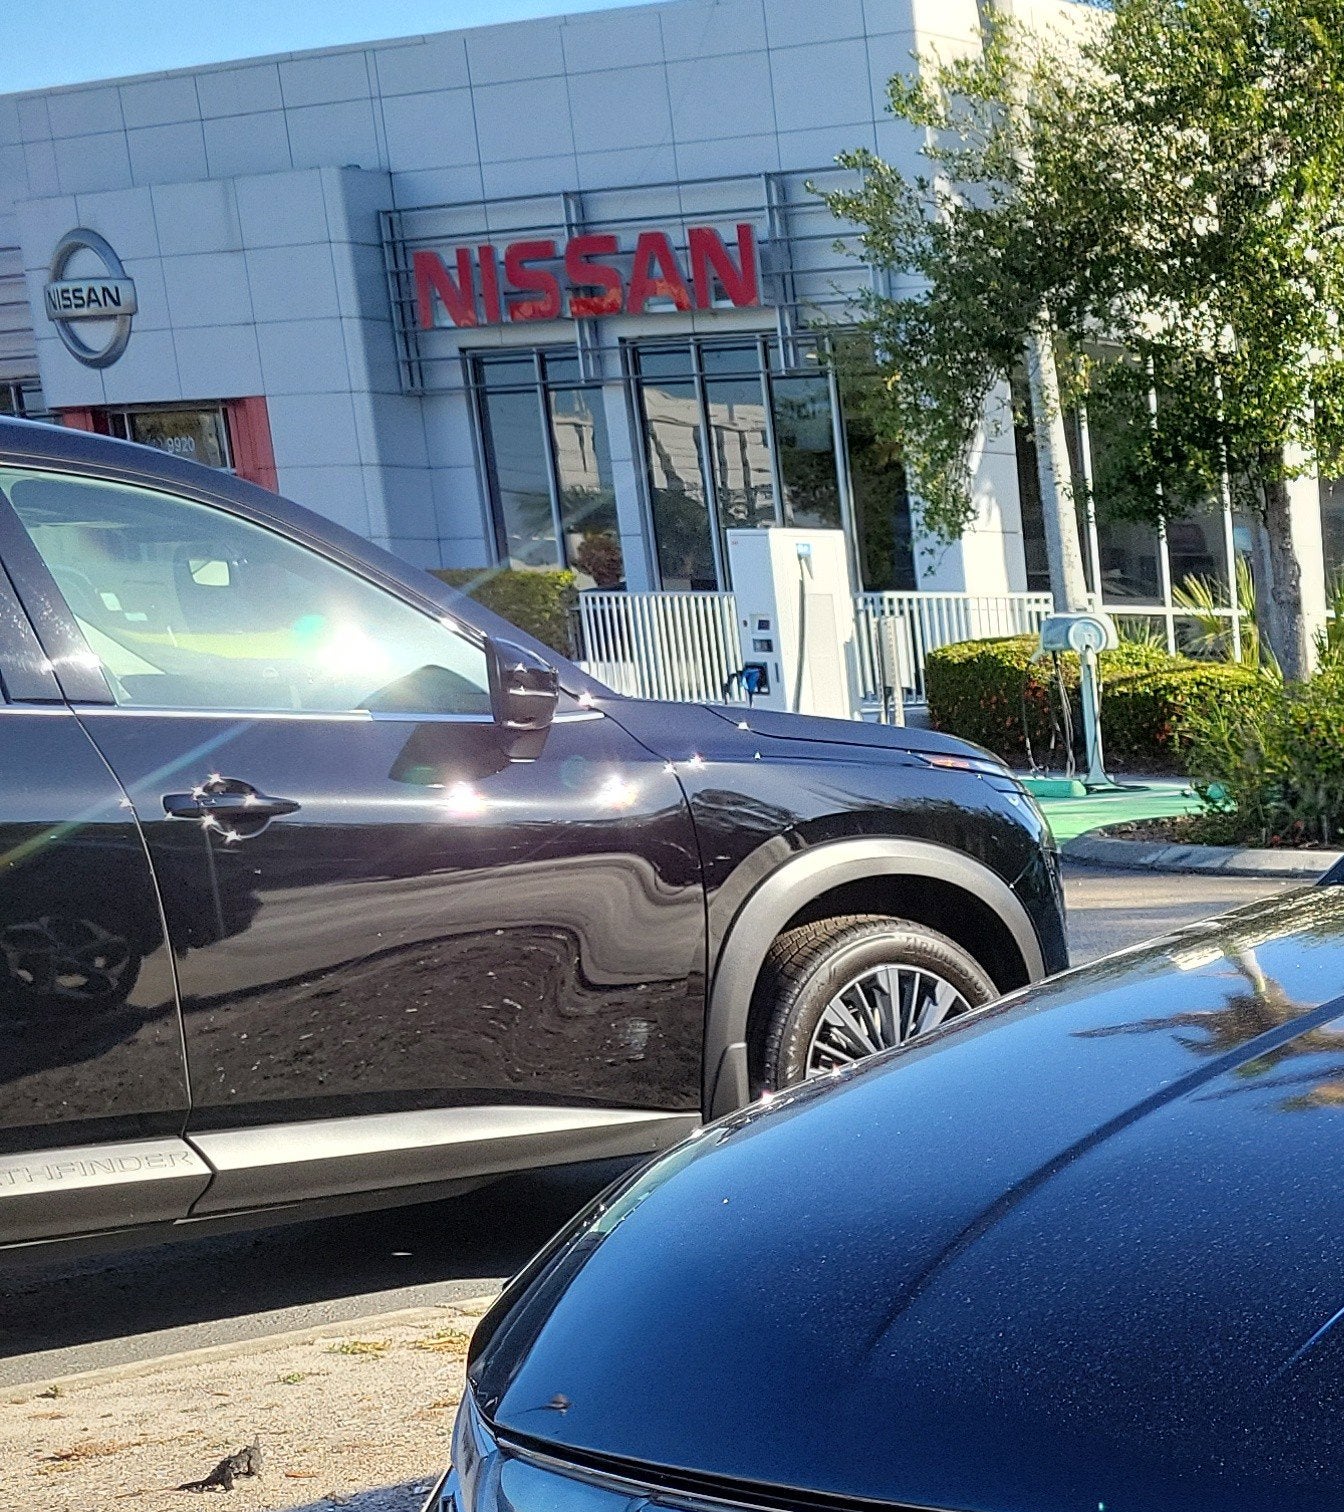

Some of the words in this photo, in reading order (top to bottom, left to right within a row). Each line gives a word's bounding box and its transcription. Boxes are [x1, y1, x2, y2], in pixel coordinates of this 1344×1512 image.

[412, 222, 761, 330] NISSAN
[47, 285, 122, 312] NISSAN
[0, 1150, 194, 1187] THFINDER
